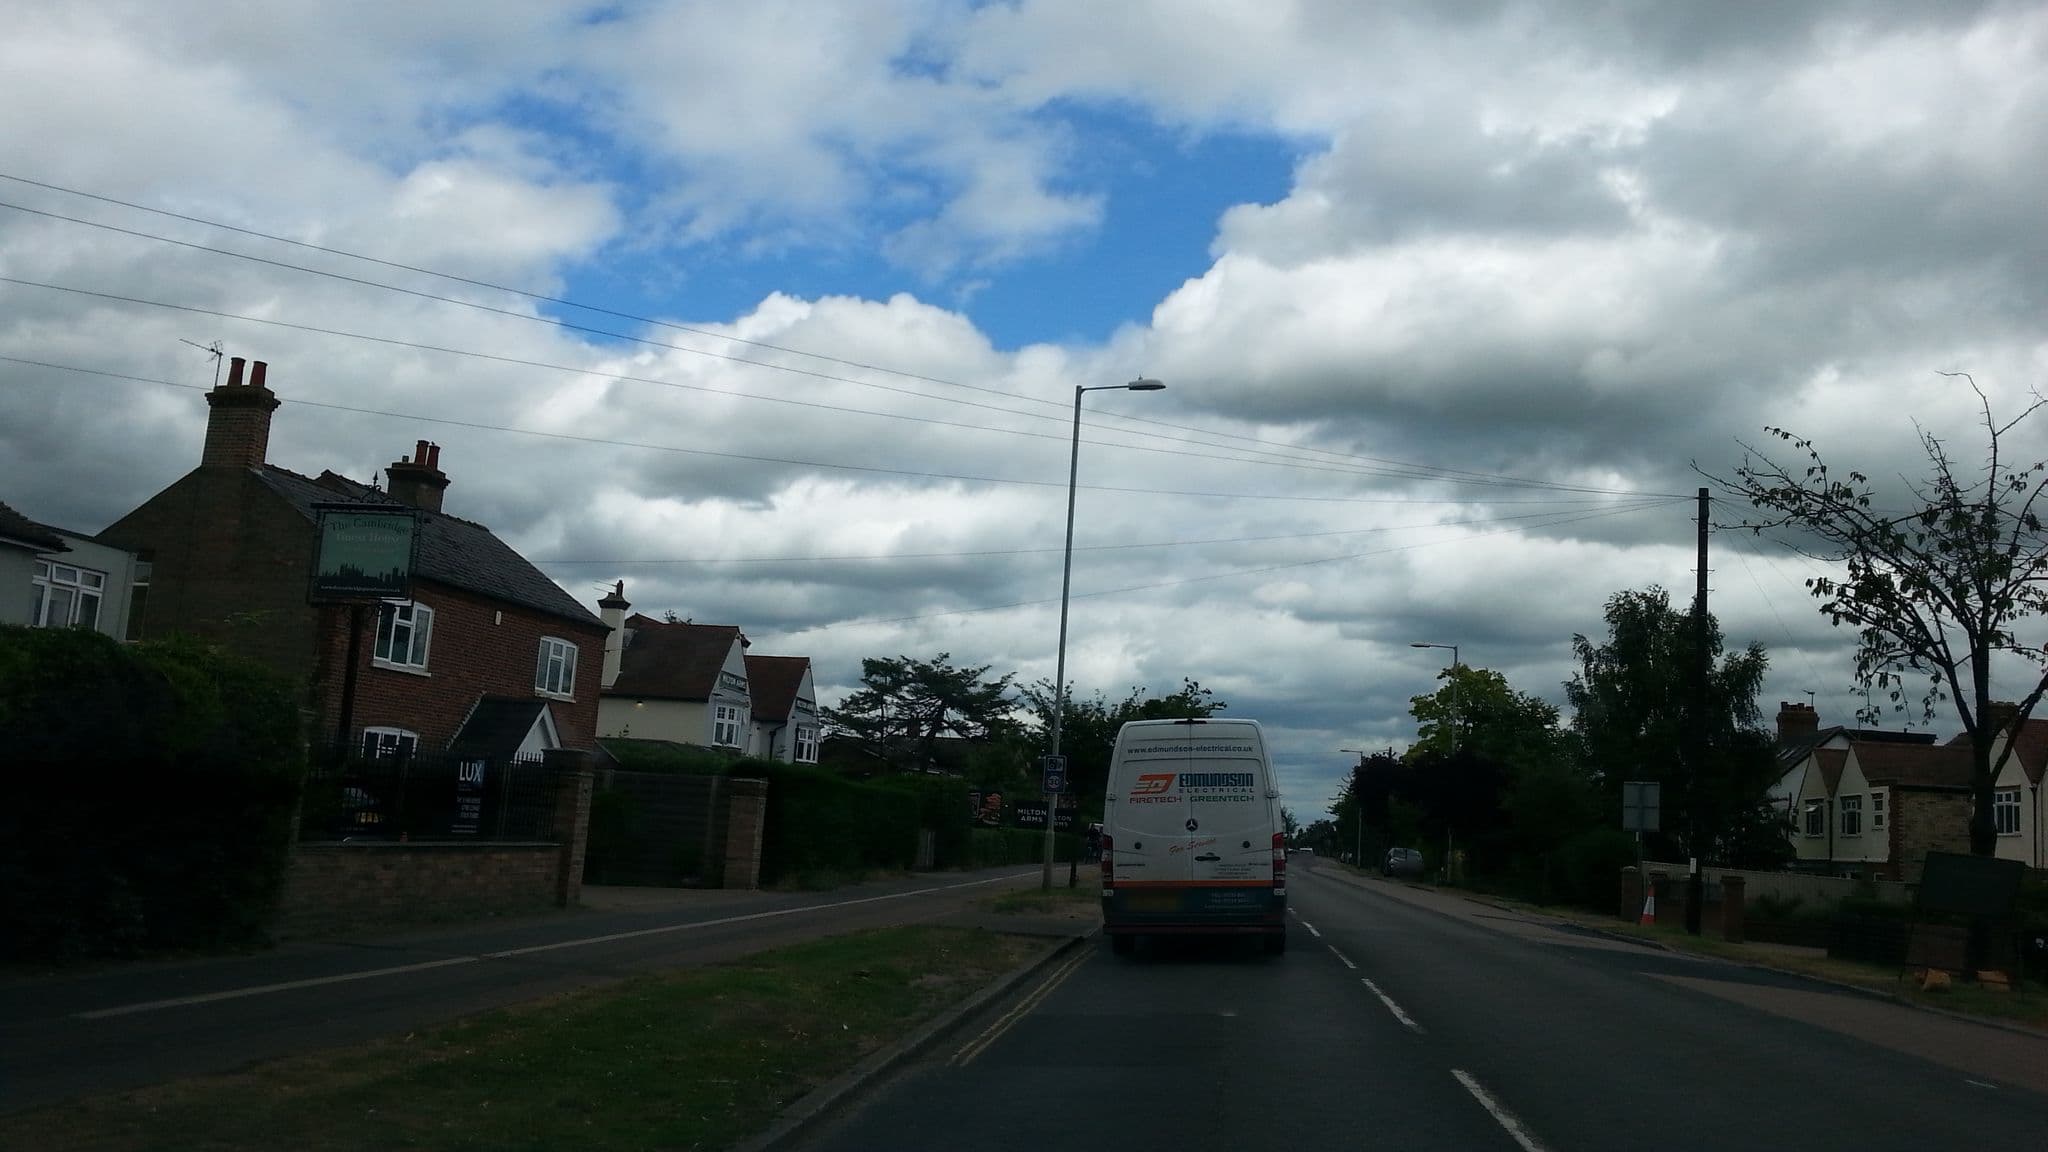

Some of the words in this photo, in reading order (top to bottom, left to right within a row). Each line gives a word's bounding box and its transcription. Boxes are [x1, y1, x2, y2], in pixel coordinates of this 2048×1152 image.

[350, 518, 409, 535] Cambridge
[336, 533, 366, 544] Guest
[370, 532, 400, 543] House
[1127, 745, 1253, 754] www.edmundson-electrical.co.uk
[459, 761, 483, 782] LUX
[1179, 773, 1254, 787] EDMUNDSON
[1130, 795, 1182, 804] FIRETECH
[1017, 808, 1048, 816] MILTON
